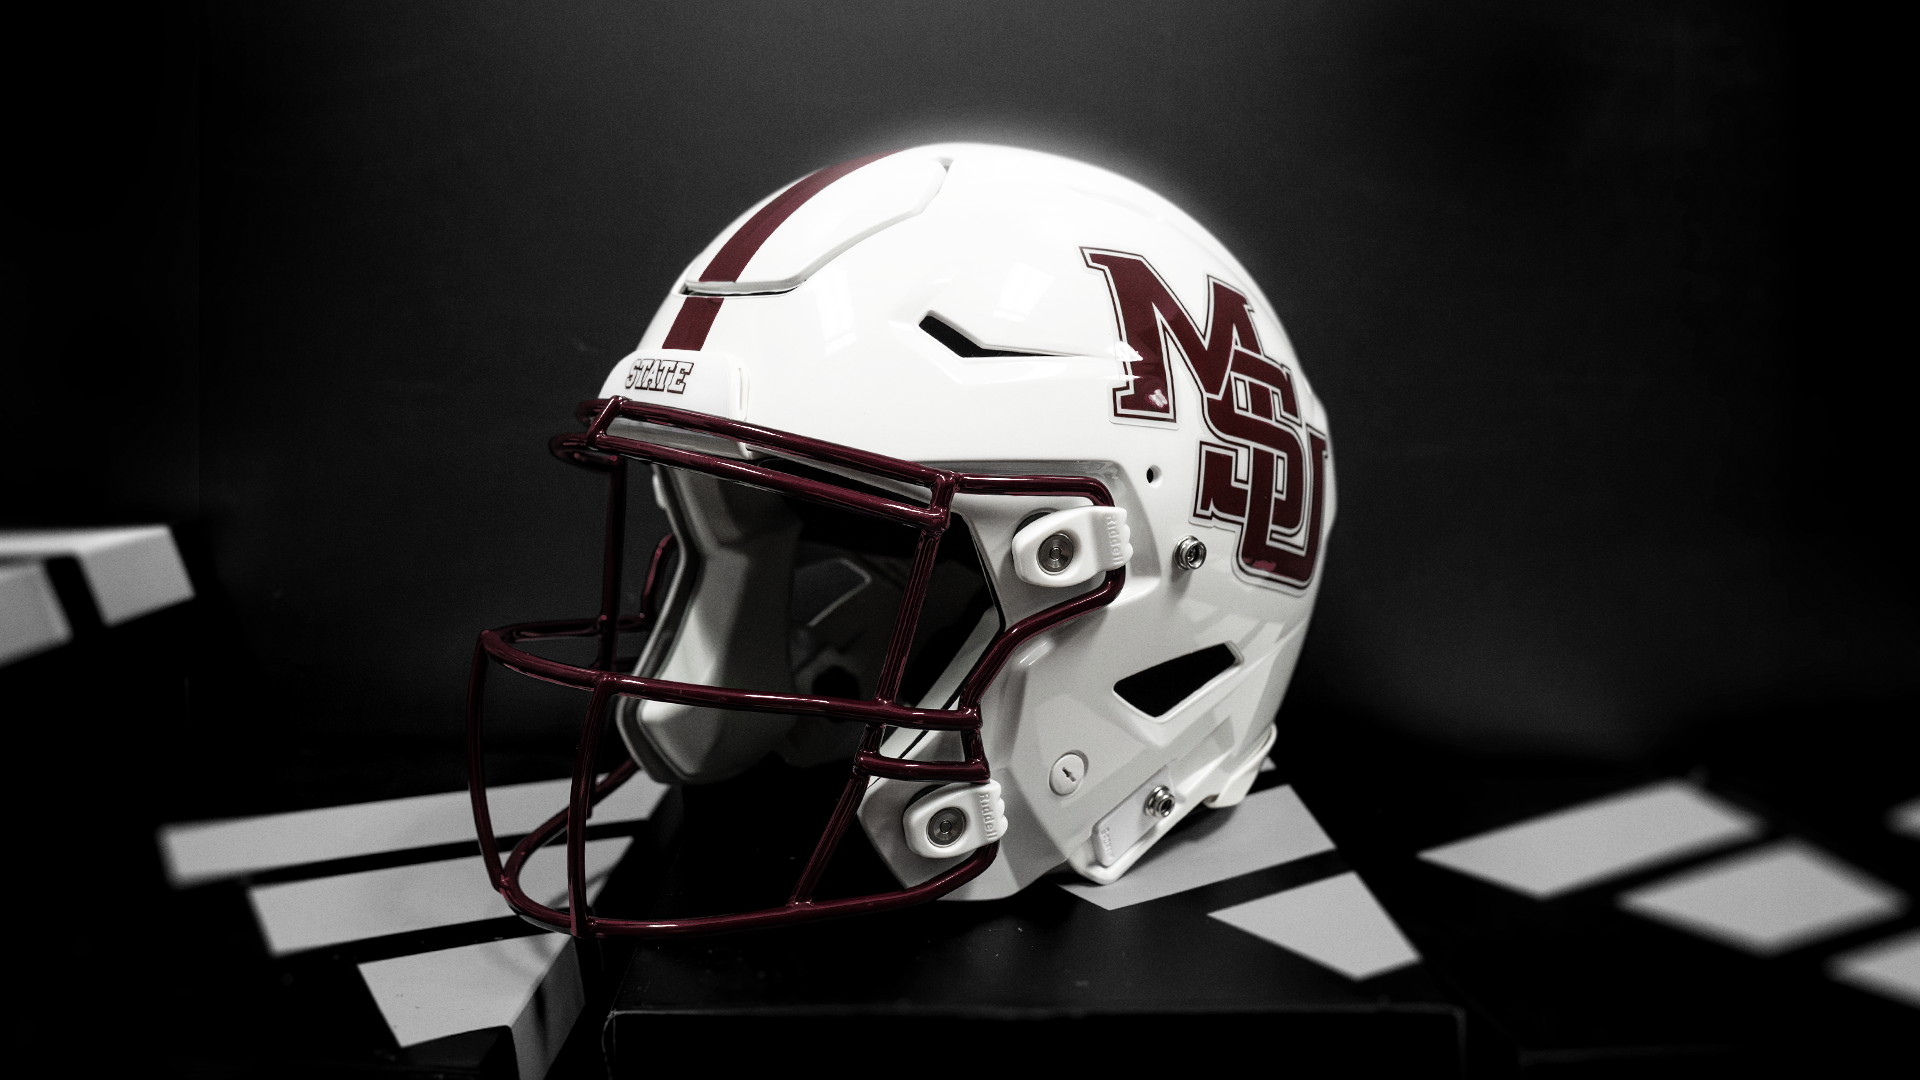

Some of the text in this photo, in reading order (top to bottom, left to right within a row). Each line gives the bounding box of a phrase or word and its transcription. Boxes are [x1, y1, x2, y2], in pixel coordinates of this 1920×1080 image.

[625, 358, 695, 395] STATE
[1079, 245, 1327, 590] MSU
[1106, 515, 1124, 565] Riddell
[979, 793, 998, 840] Riddell
